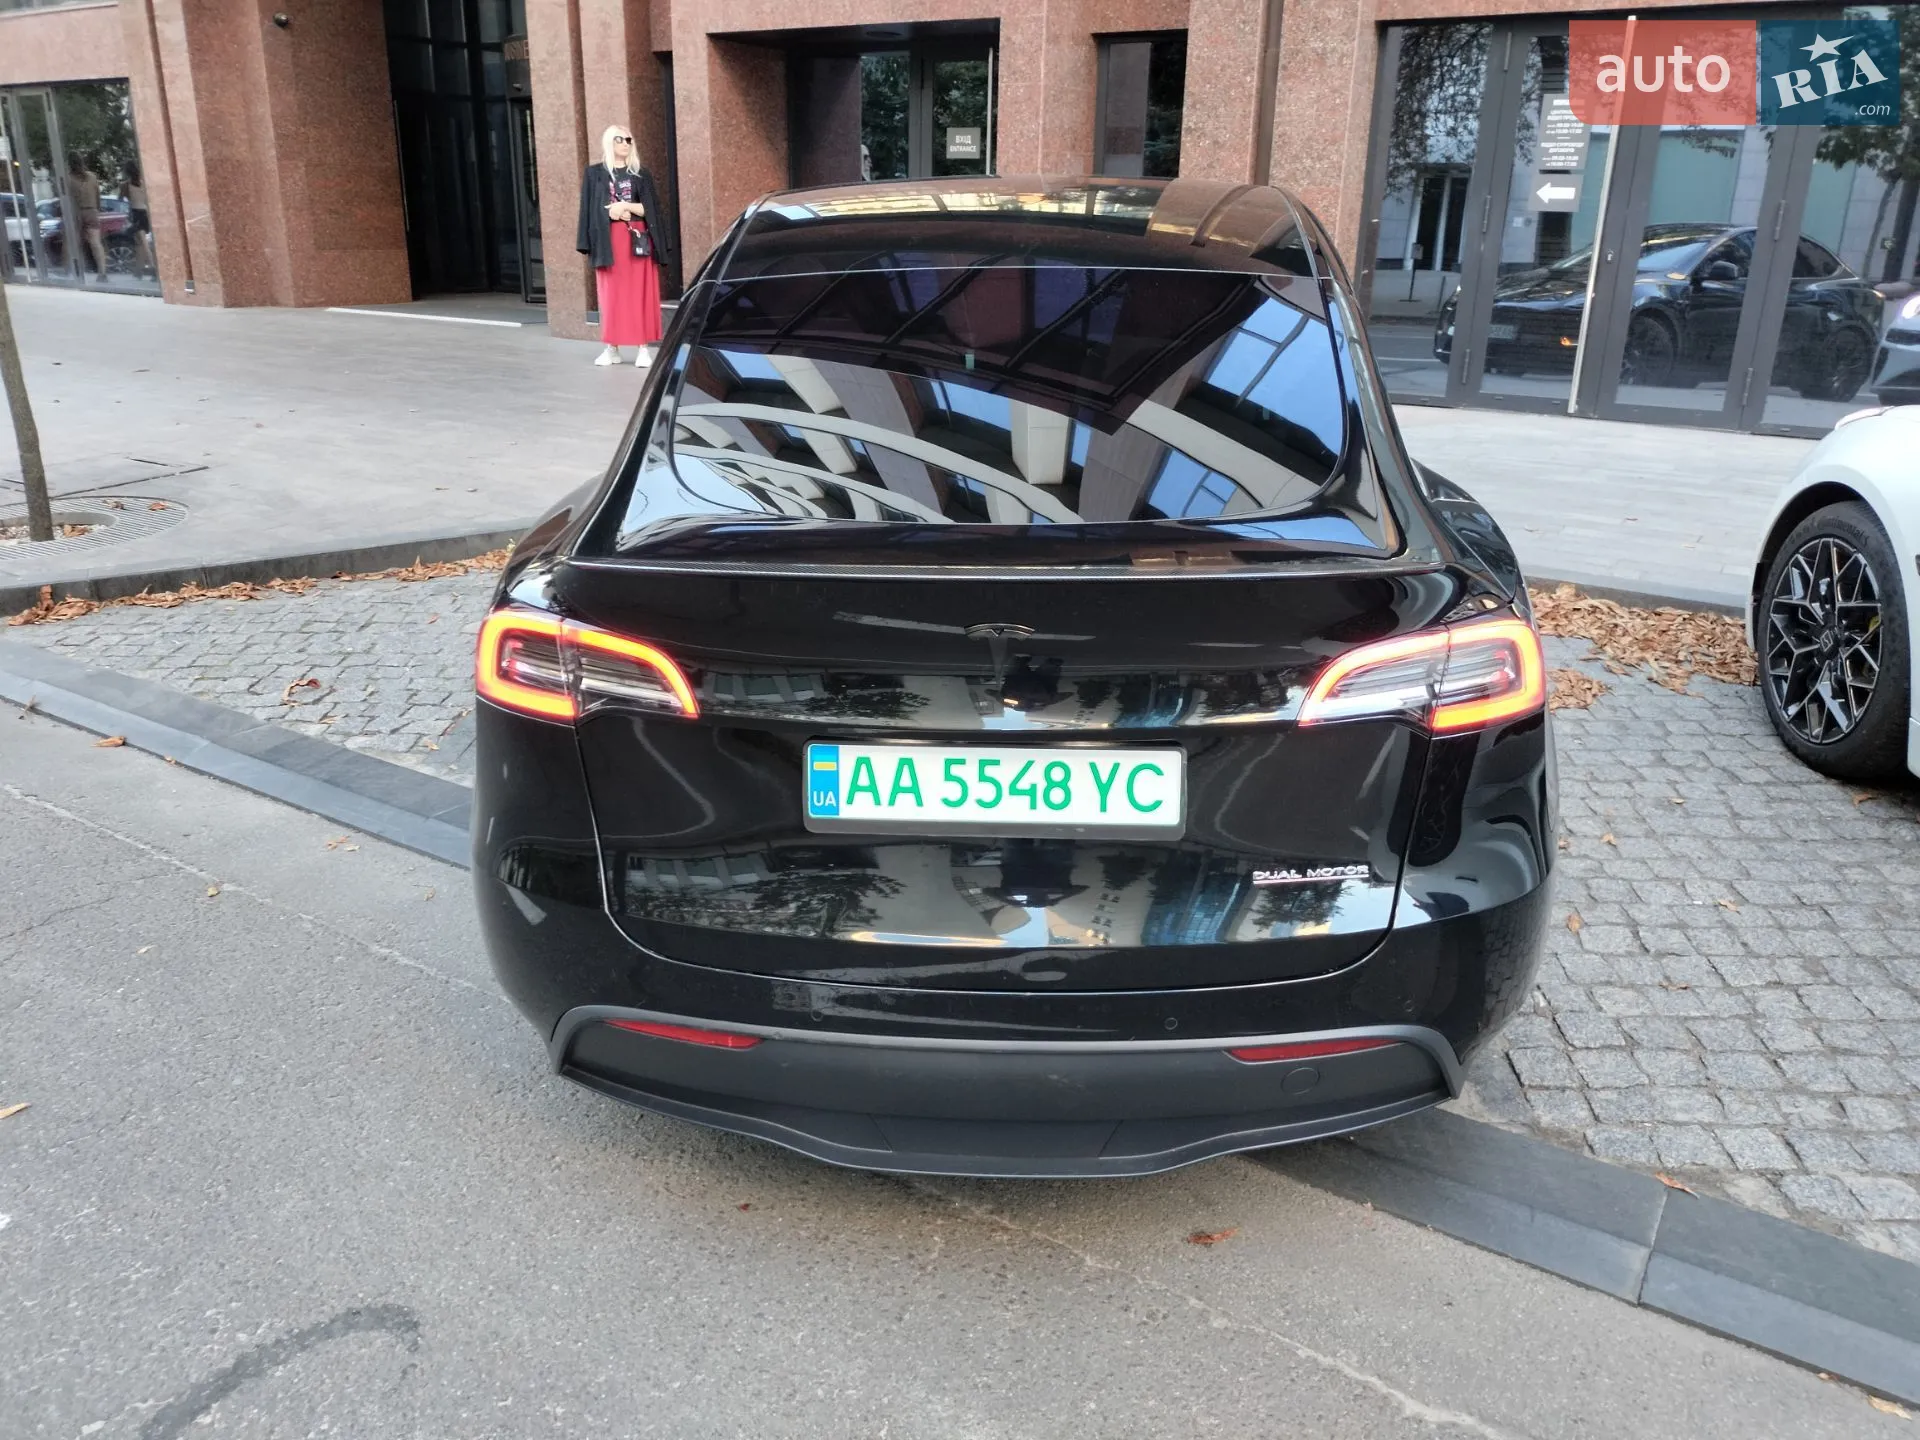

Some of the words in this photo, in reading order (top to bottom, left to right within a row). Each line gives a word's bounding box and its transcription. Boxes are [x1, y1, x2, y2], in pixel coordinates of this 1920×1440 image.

[846, 756, 924, 807] AA
[940, 758, 1072, 811] 5548
[1089, 761, 1165, 813] YC
[813, 790, 837, 807] UA
[1252, 869, 1302, 880] DUAL
[1306, 865, 1369, 877] MOTOR
